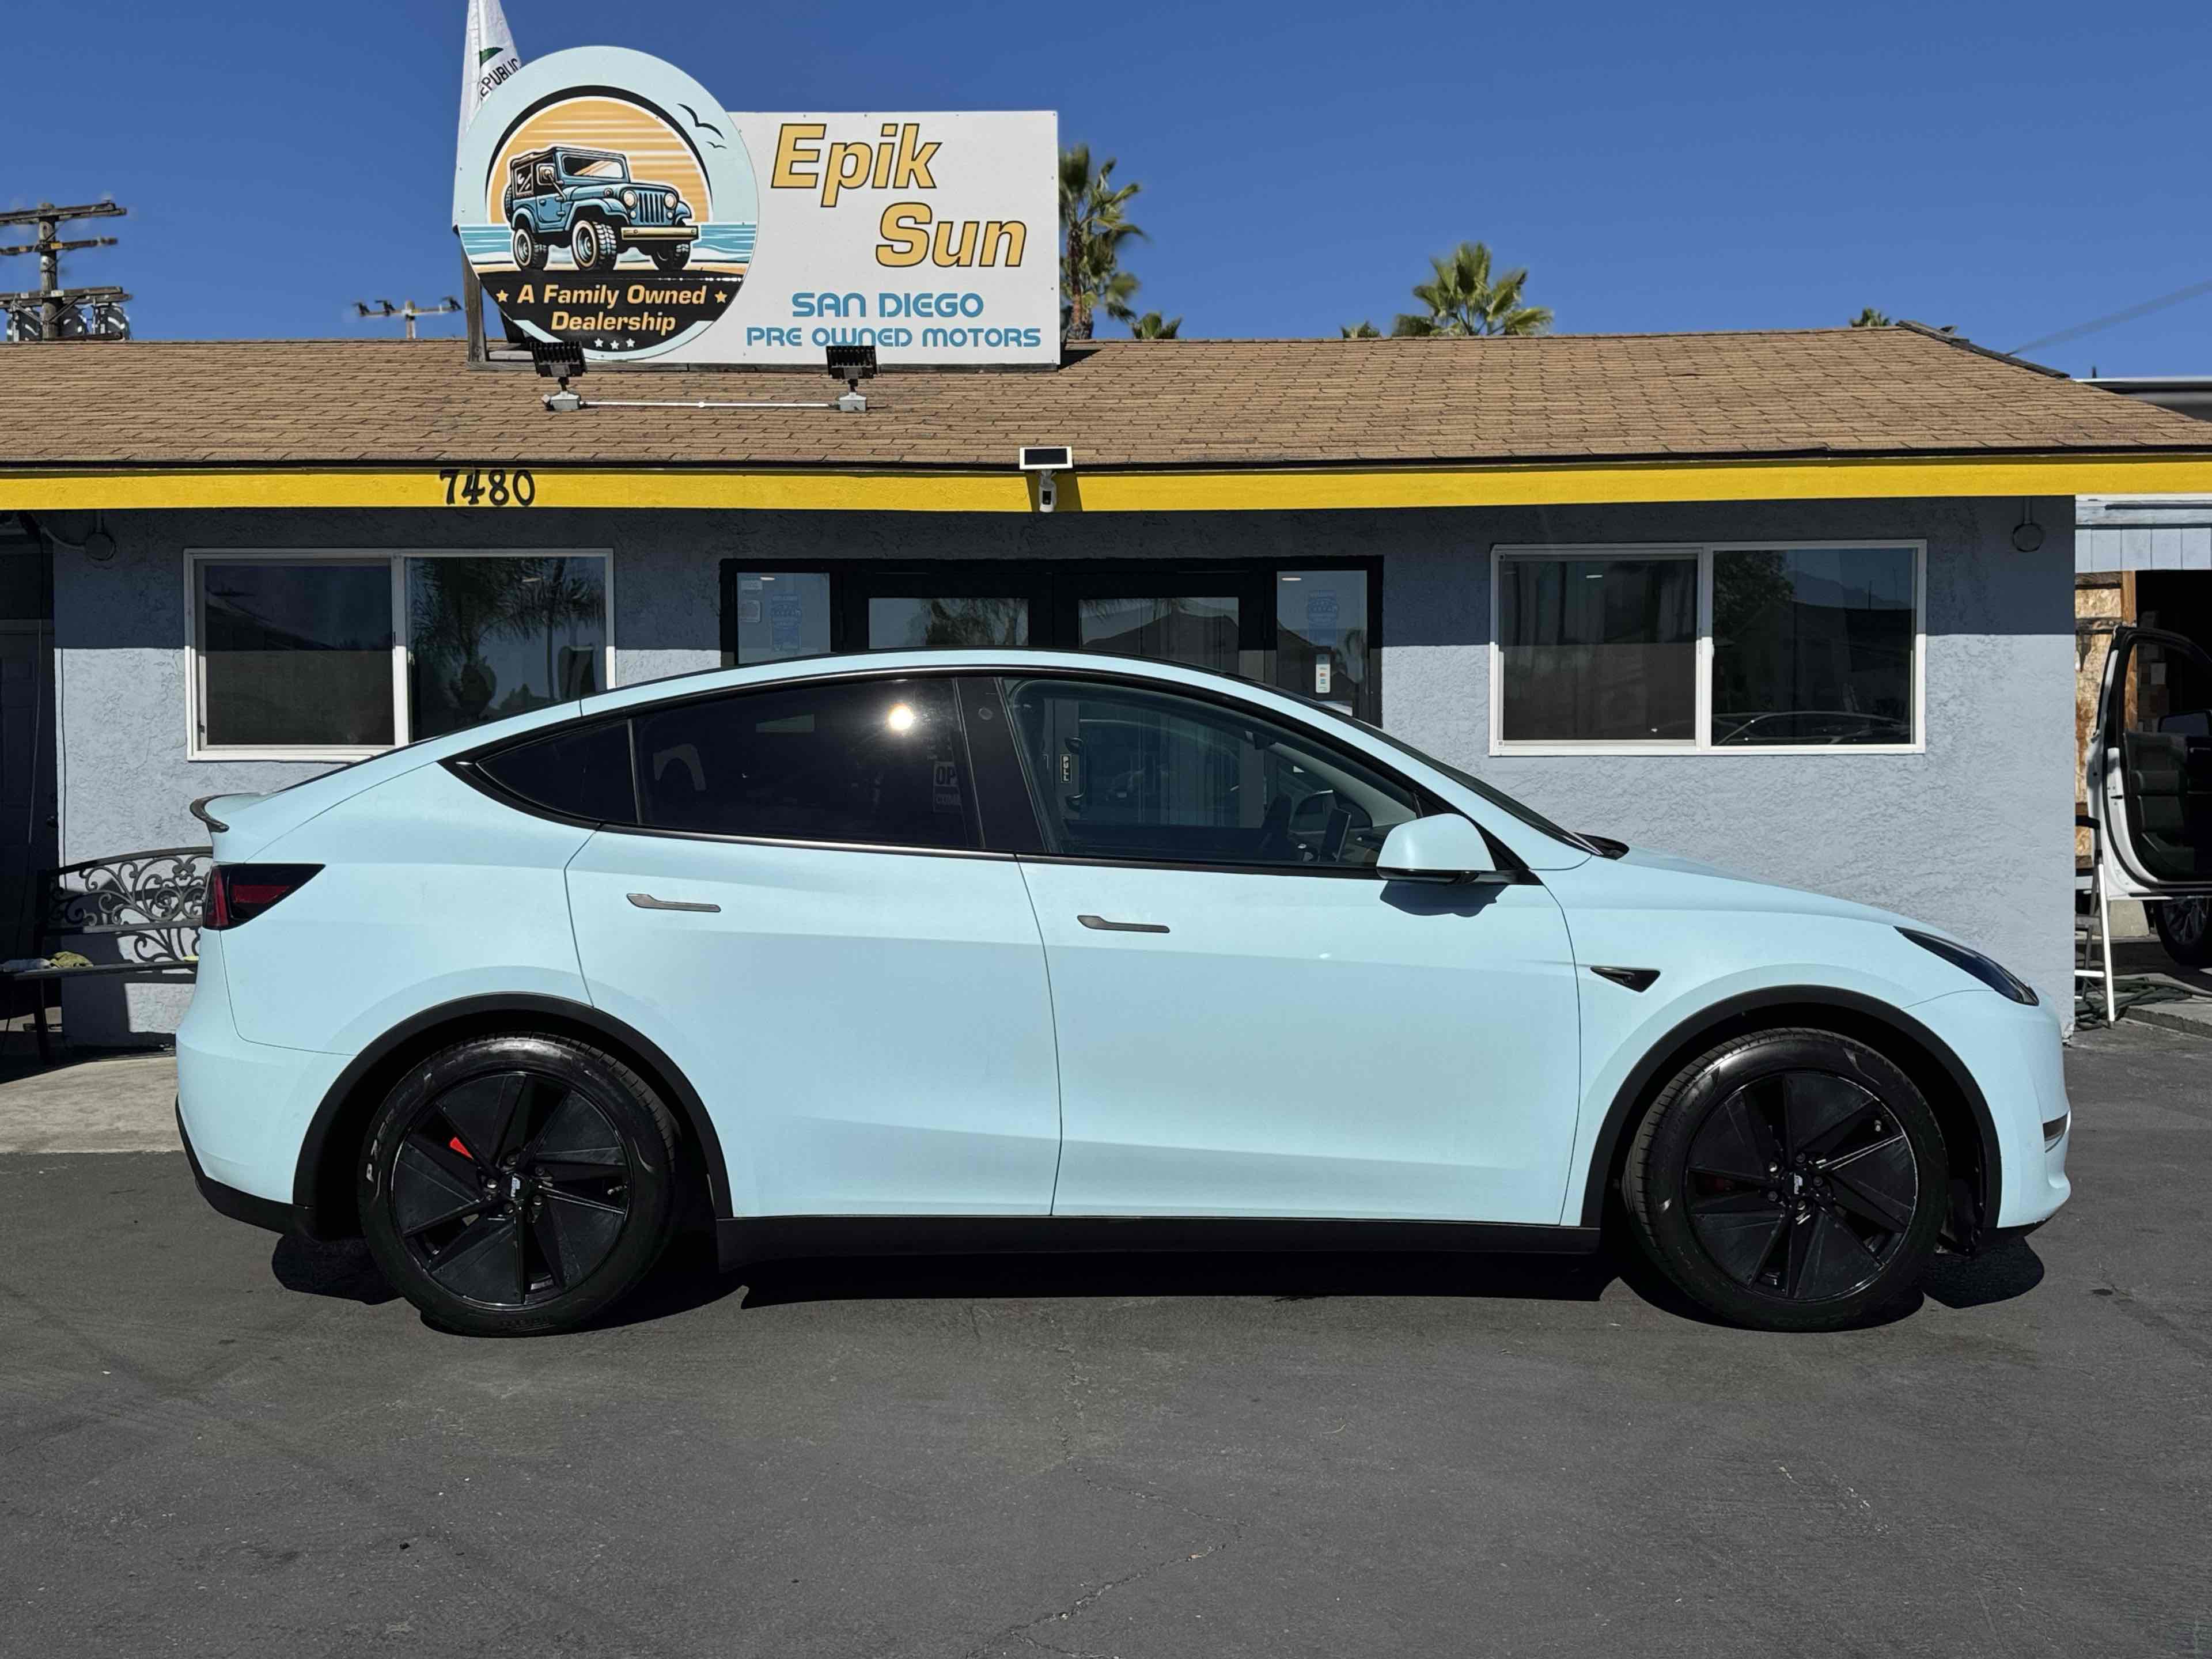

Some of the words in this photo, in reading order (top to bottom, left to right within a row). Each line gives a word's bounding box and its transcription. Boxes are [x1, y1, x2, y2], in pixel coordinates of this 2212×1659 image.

[479, 58, 519, 99] EPUBLIC
[770, 123, 943, 207] Epik
[876, 202, 1027, 268] Sun
[517, 285, 535, 304] A
[543, 285, 619, 309] Family
[626, 285, 707, 305] Owned
[791, 291, 866, 318] SAN
[878, 291, 984, 318] DIEGO
[551, 311, 676, 333] Dealership
[747, 326, 802, 347] PRE
[811, 326, 913, 347] OWNED
[922, 326, 1042, 347] MOTORS
[440, 469, 535, 506] 7480
[935, 766, 957, 785] OP
